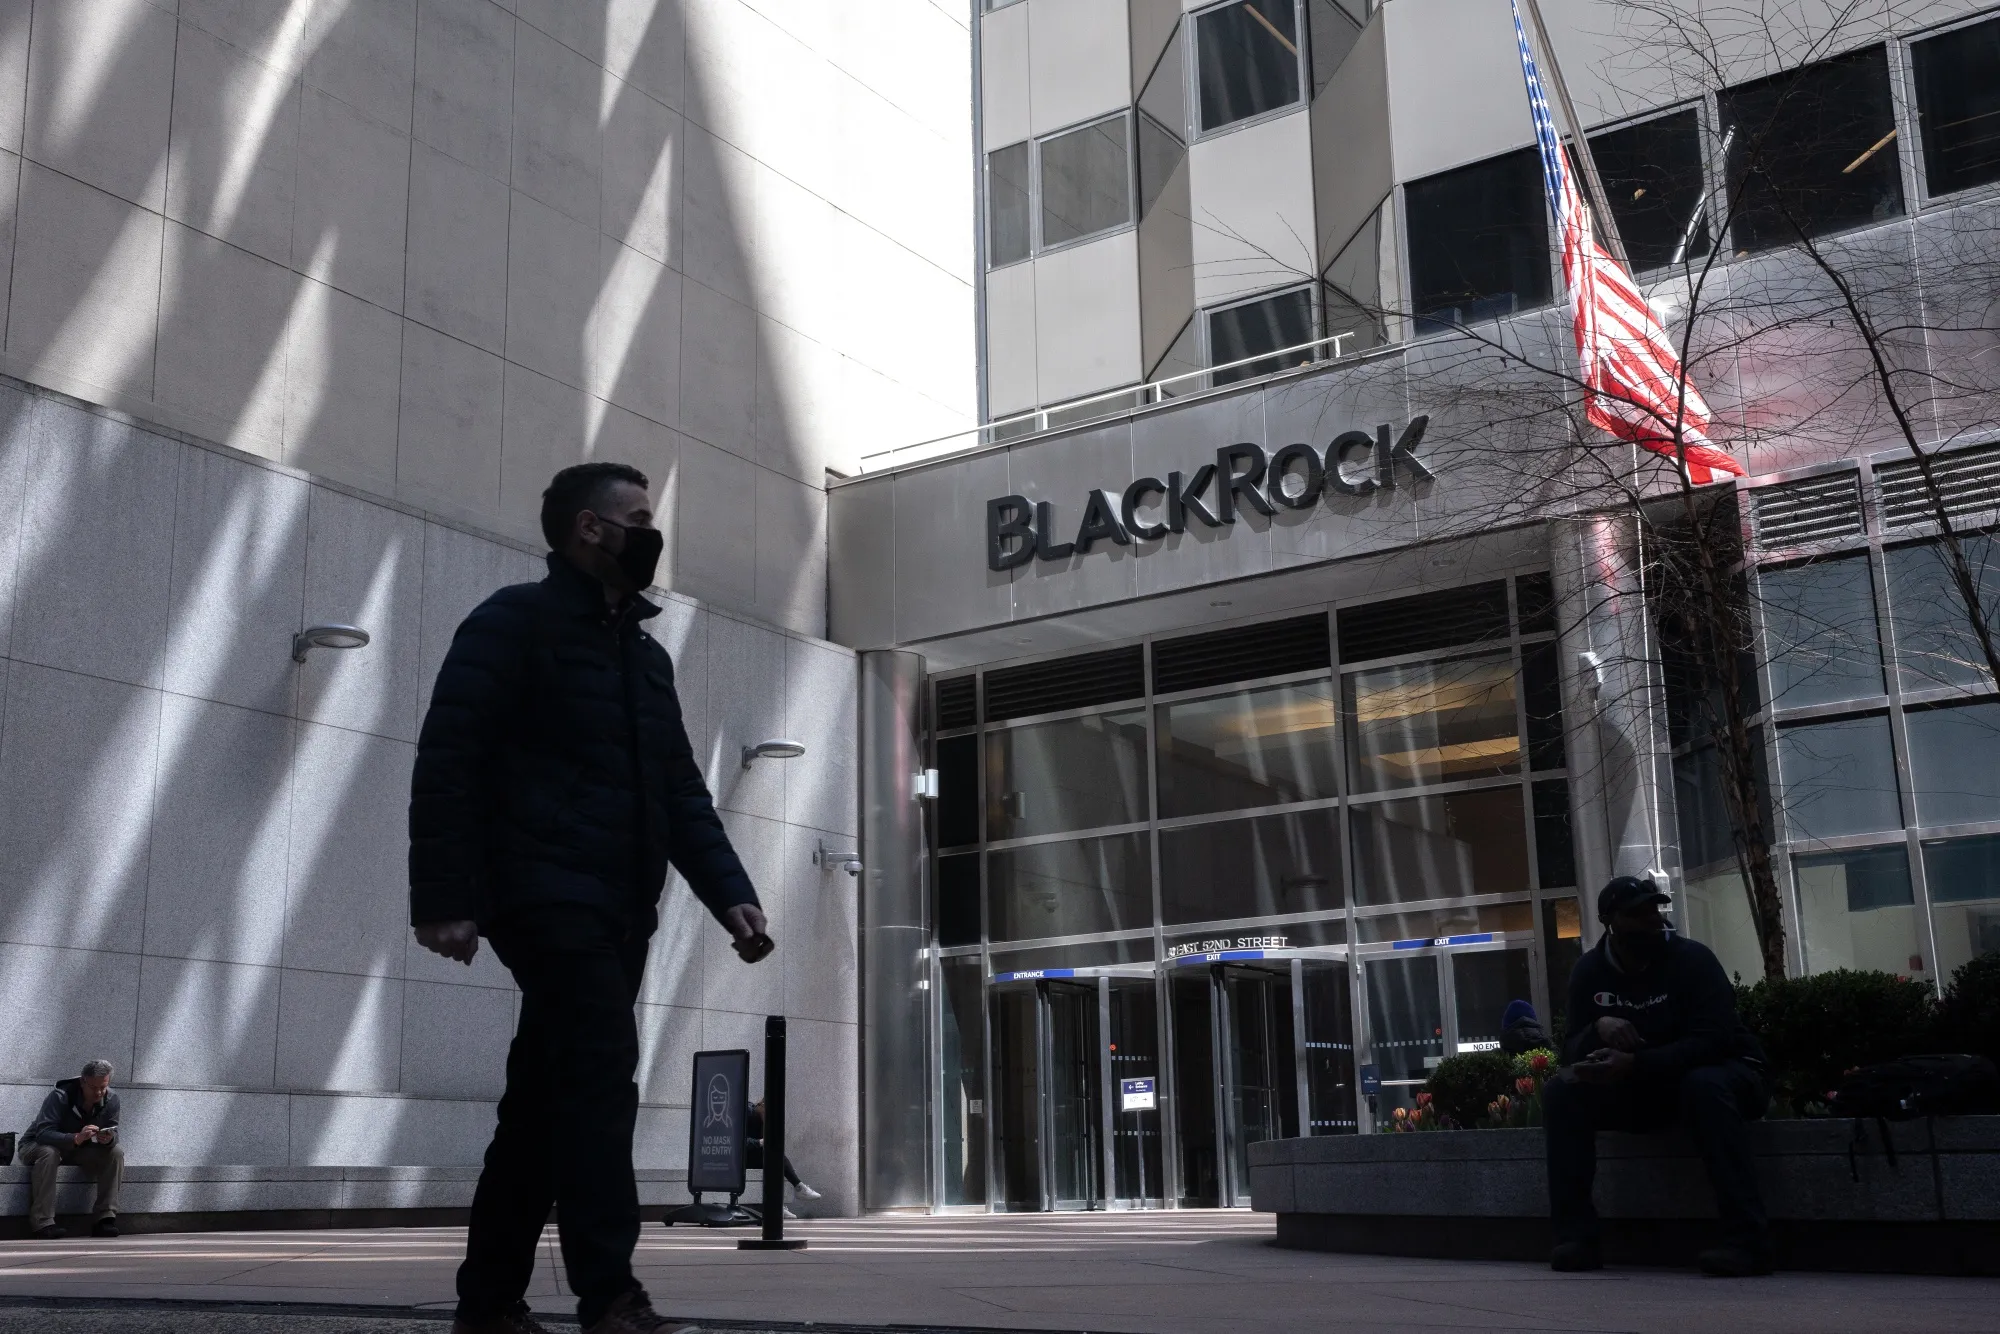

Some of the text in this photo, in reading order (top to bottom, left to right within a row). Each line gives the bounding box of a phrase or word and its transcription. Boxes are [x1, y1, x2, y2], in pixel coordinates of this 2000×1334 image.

[987, 415, 1436, 571] BLACKROCK
[1176, 941, 1199, 955] EAST
[1202, 939, 1231, 952] 52ND
[1237, 936, 1288, 948] STREET
[1434, 938, 1450, 946] EXIT
[1206, 953, 1221, 961] EXIT
[1013, 970, 1044, 979] ENTRANCE
[1473, 1042, 1500, 1051] NO ENT
[703, 1135, 731, 1145] NO MASK
[701, 1145, 732, 1155] NO ENTRY
